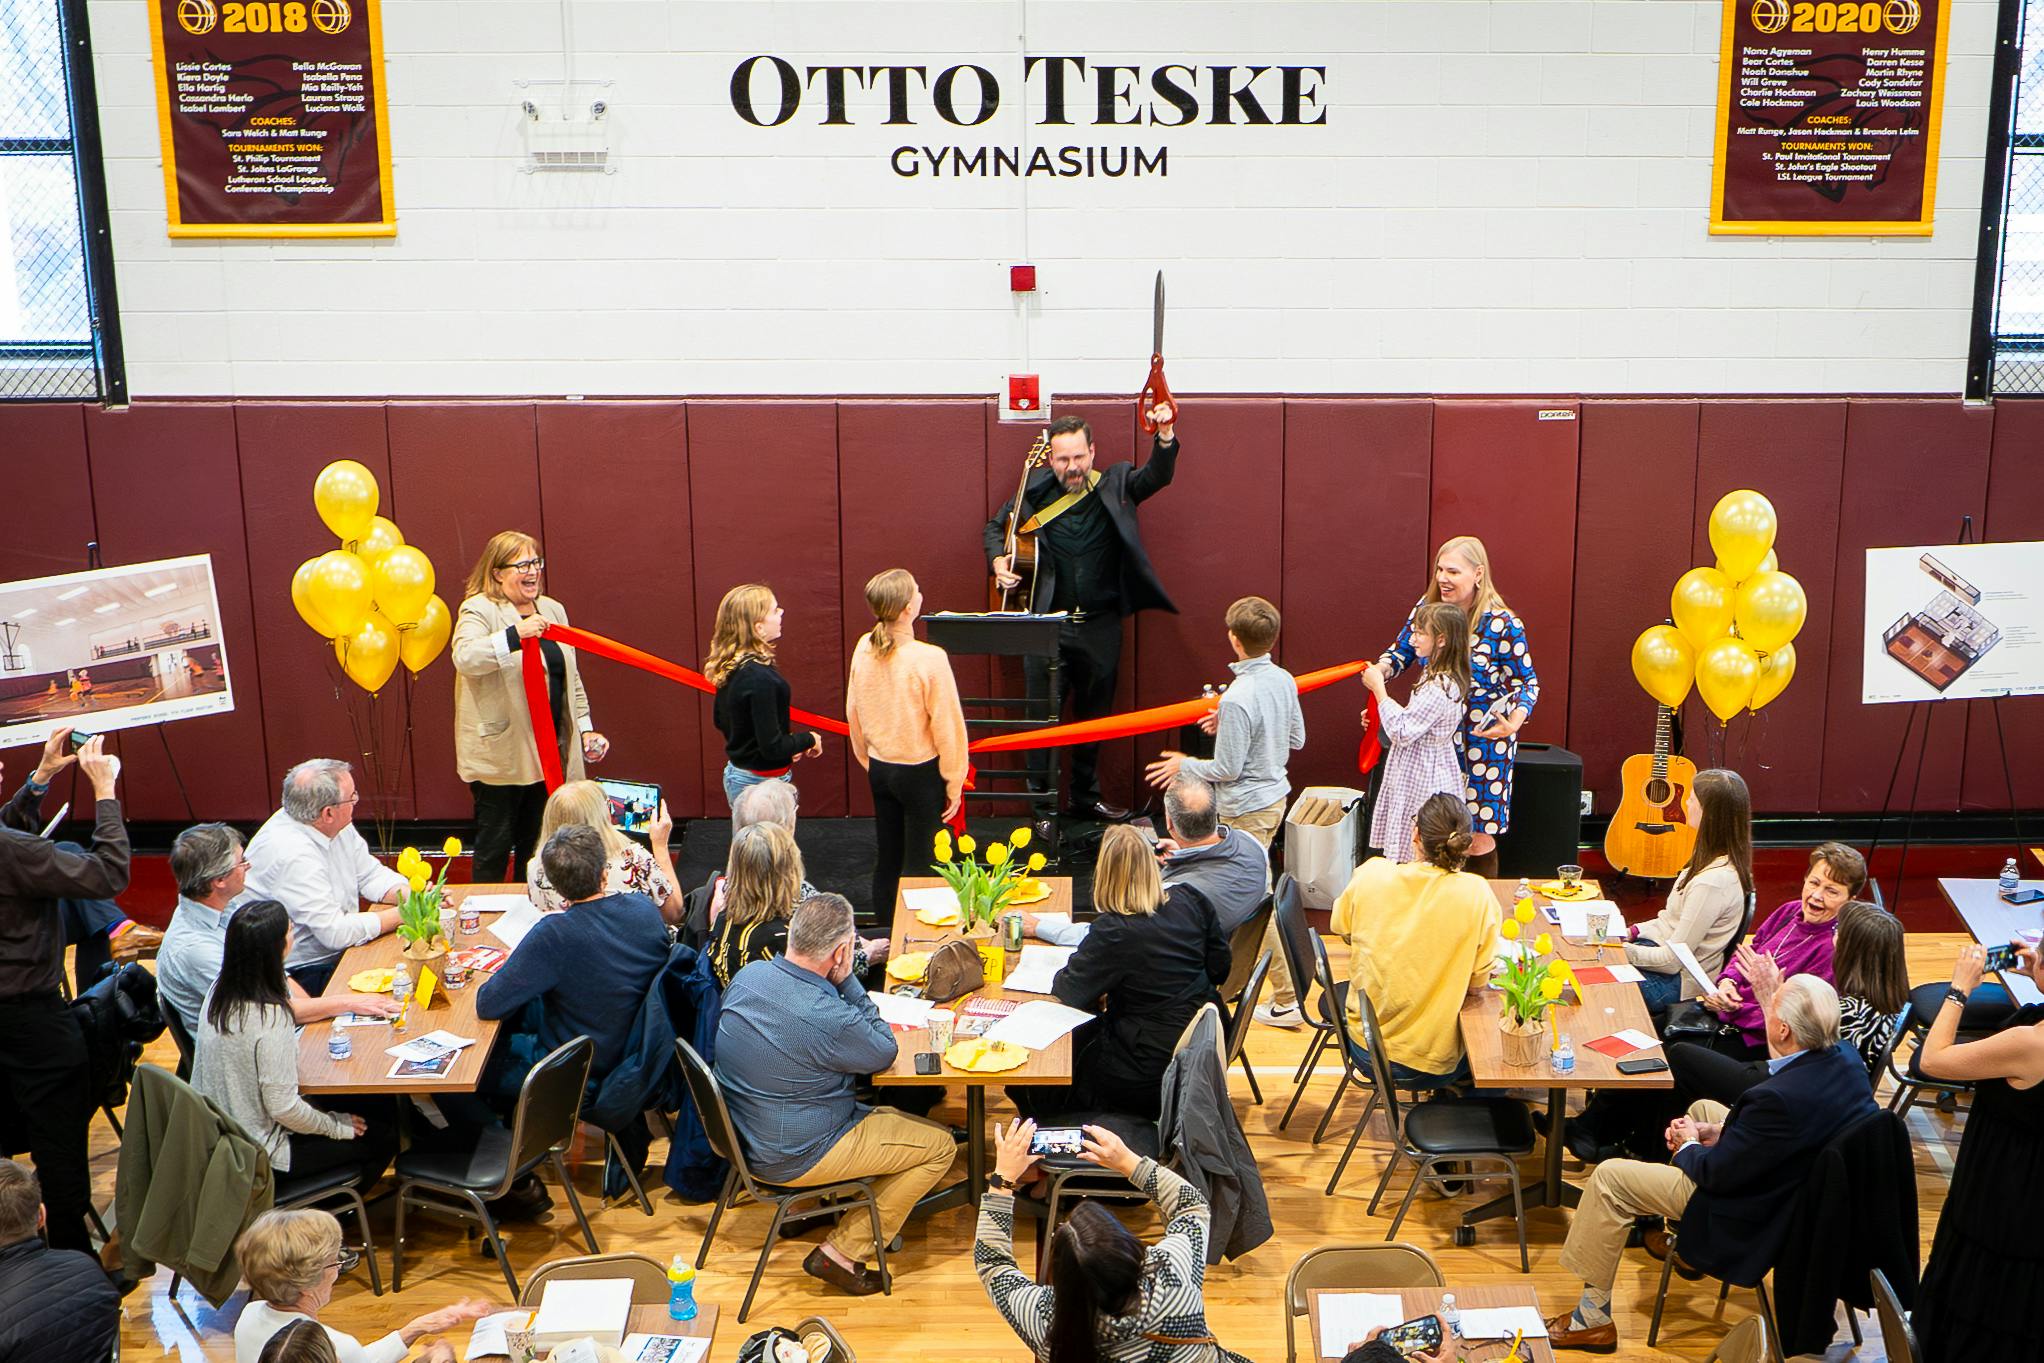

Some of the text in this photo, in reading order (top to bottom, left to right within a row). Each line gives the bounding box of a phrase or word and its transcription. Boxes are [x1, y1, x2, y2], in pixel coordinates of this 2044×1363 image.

[222, 2, 307, 32] 2018
[1792, 3, 1881, 32] 2020
[1769, 47, 1812, 57] Agyeman
[1862, 48, 1889, 58] Henry
[176, 62, 231, 71] Lissie Cortes
[293, 62, 362, 70] Bella McGowan
[1867, 58, 1897, 66] Darren
[177, 73, 229, 83] Kiera Doyle
[303, 73, 338, 81] Isabella
[1866, 68, 1923, 78] Martin Rhyne
[302, 83, 363, 93] Mia Reilly-Yeh
[1858, 78, 1923, 88] Cody Sandefur
[730, 55, 1328, 127] OTTO TESKE
[1741, 88, 1816, 96] Charlie Hockman
[1841, 88, 1876, 98] Zachary
[179, 94, 226, 102] Cassandra
[1856, 99, 1879, 107] Louis
[180, 104, 246, 112] Isabel Lambert
[305, 104, 340, 112] Luciana
[1807, 116, 1851, 124] COACHES:
[243, 129, 269, 137] Welch
[300, 129, 327, 139] Runge
[1758, 127, 1786, 137] Runge,
[229, 144, 294, 152] TOURNAMENTS
[245, 154, 270, 164] Philip
[890, 145, 1168, 178] GYMNASIUM
[1816, 163, 1838, 173] Eagle
[266, 175, 294, 183] School
[296, 176, 327, 185] League
[1793, 173, 1822, 183] League
[274, 184, 334, 195] Championship
